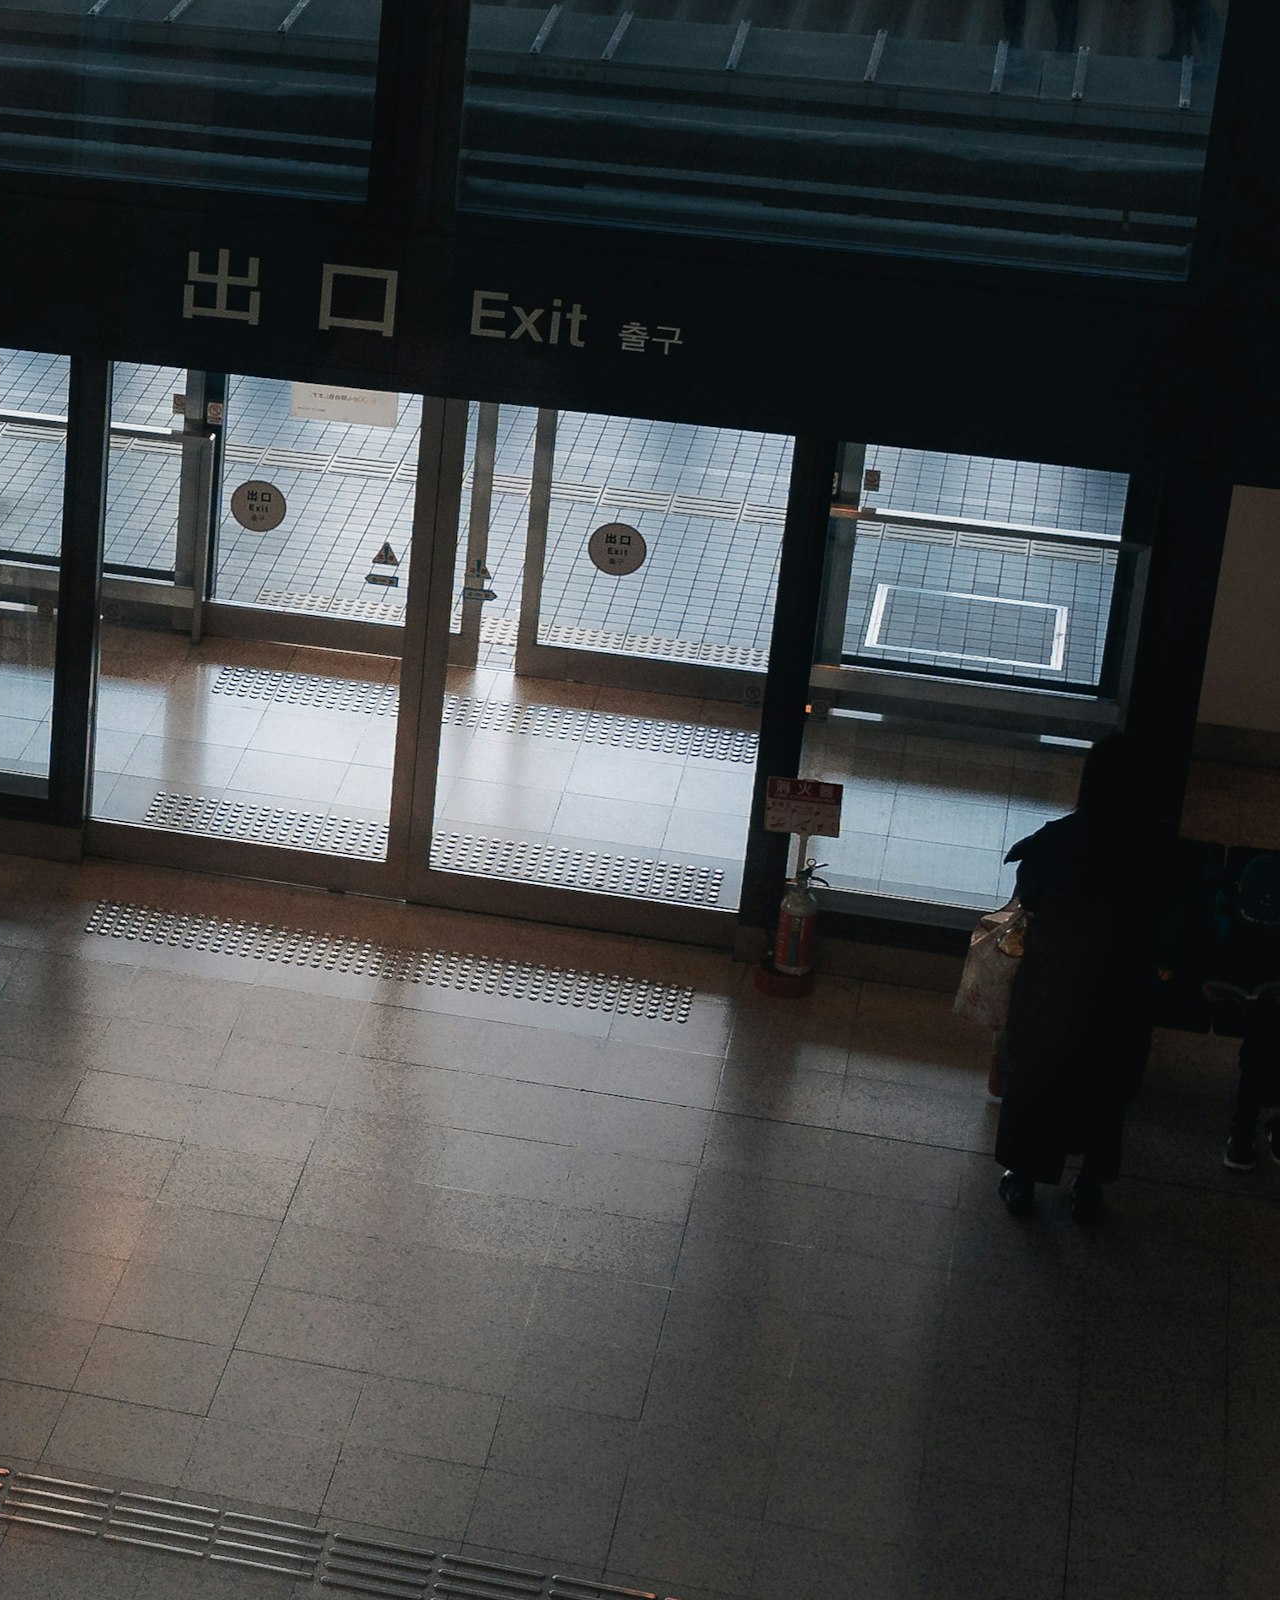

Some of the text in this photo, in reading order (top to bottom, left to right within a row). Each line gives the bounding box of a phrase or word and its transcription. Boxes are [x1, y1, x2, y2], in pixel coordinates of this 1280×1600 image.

[182, 248, 685, 357] 出口 Exit 출구
[247, 491, 272, 503] 出口
[249, 503, 269, 513] Exit
[605, 533, 631, 546] 出口
[607, 546, 628, 557] Exit
[775, 780, 835, 799] 消火器
